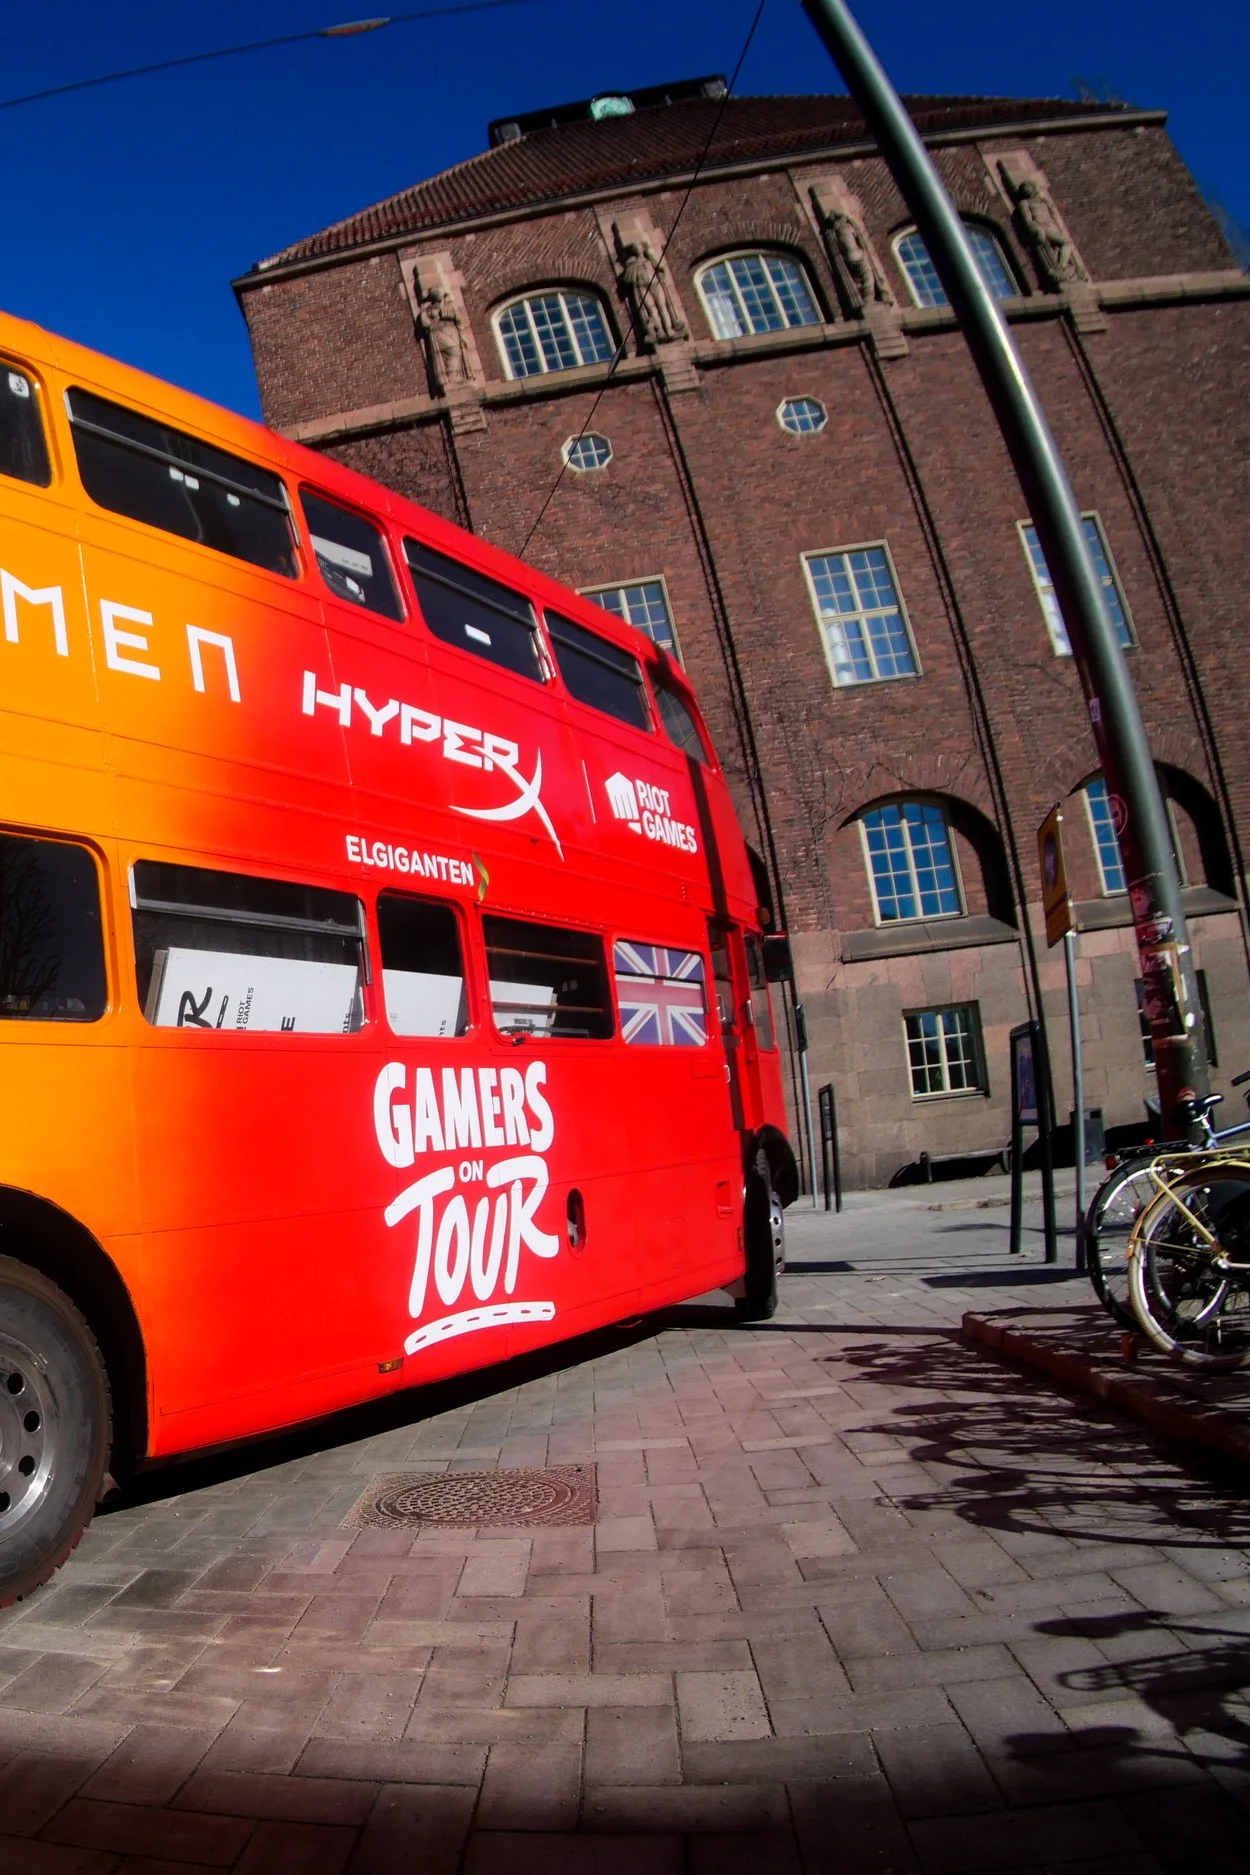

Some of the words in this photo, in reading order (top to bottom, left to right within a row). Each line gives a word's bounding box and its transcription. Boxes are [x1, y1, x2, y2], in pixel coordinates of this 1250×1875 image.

[635, 779, 671, 817] RIOT
[642, 810, 697, 853] GAMES
[345, 834, 475, 886] ELGIGANTEN
[236, 1000, 246, 1024] RIOT
[242, 986, 255, 1025] GAMES
[373, 1060, 554, 1168] GAMERS
[458, 1159, 484, 1184] ON
[384, 1155, 560, 1319] TOUR
